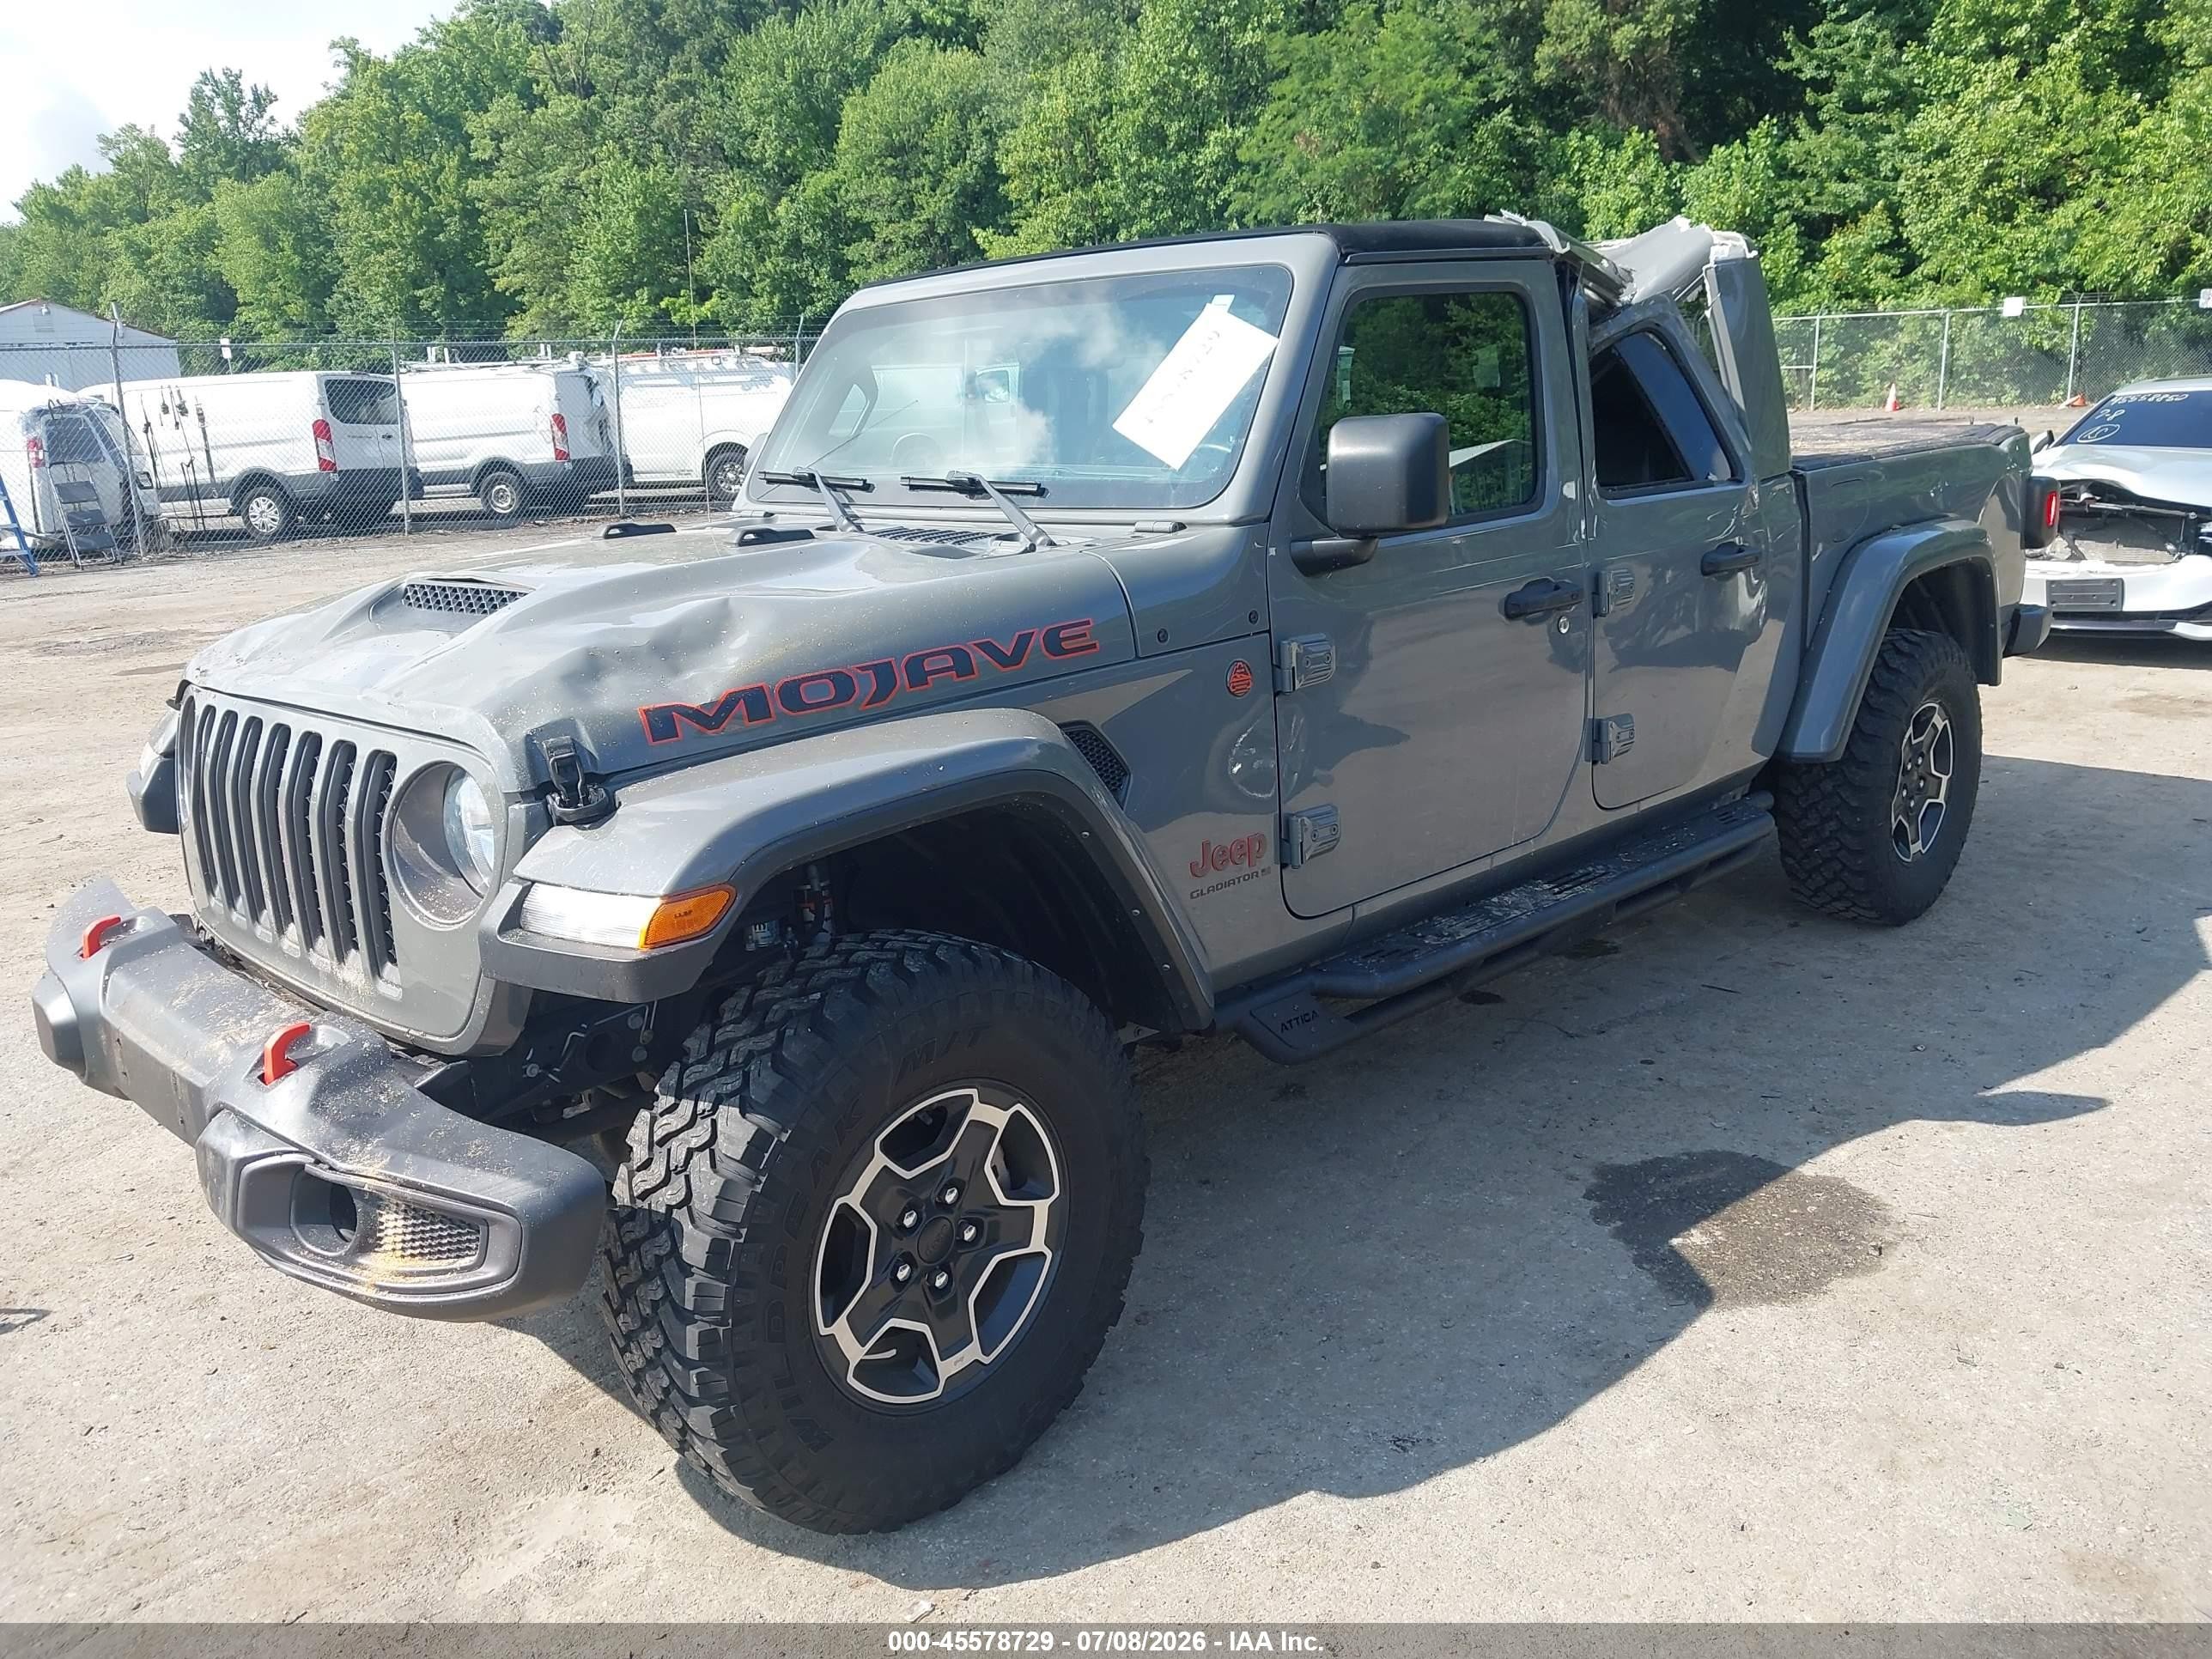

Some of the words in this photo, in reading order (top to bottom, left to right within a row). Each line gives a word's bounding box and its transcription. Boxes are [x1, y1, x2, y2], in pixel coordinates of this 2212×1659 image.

[638, 617, 1100, 745] MOJAVE
[1189, 832, 1267, 878] Jeep
[1190, 871, 1258, 899] GLADIATOR
[1280, 1010, 1318, 1034] ATTICA
